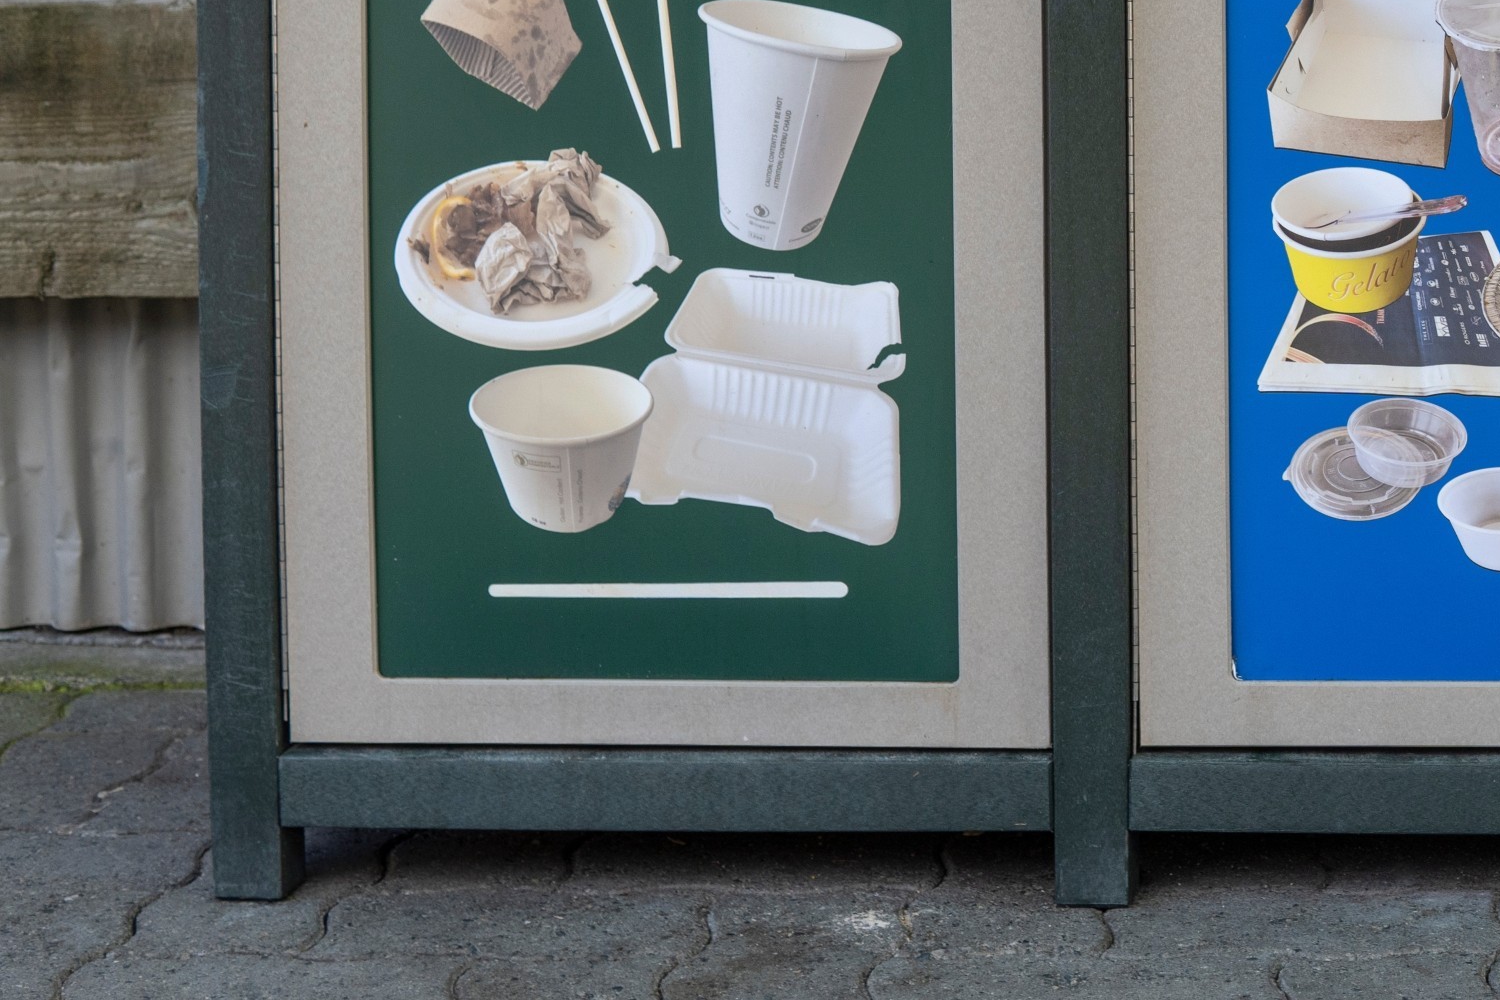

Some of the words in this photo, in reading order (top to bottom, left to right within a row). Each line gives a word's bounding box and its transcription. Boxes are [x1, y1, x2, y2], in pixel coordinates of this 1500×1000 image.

[768, 134, 778, 163] CONTENTS
[775, 111, 781, 120] BE
[783, 110, 792, 132] CHAUD
[779, 132, 788, 159] CONTENU
[1328, 250, 1410, 301] Gelato
